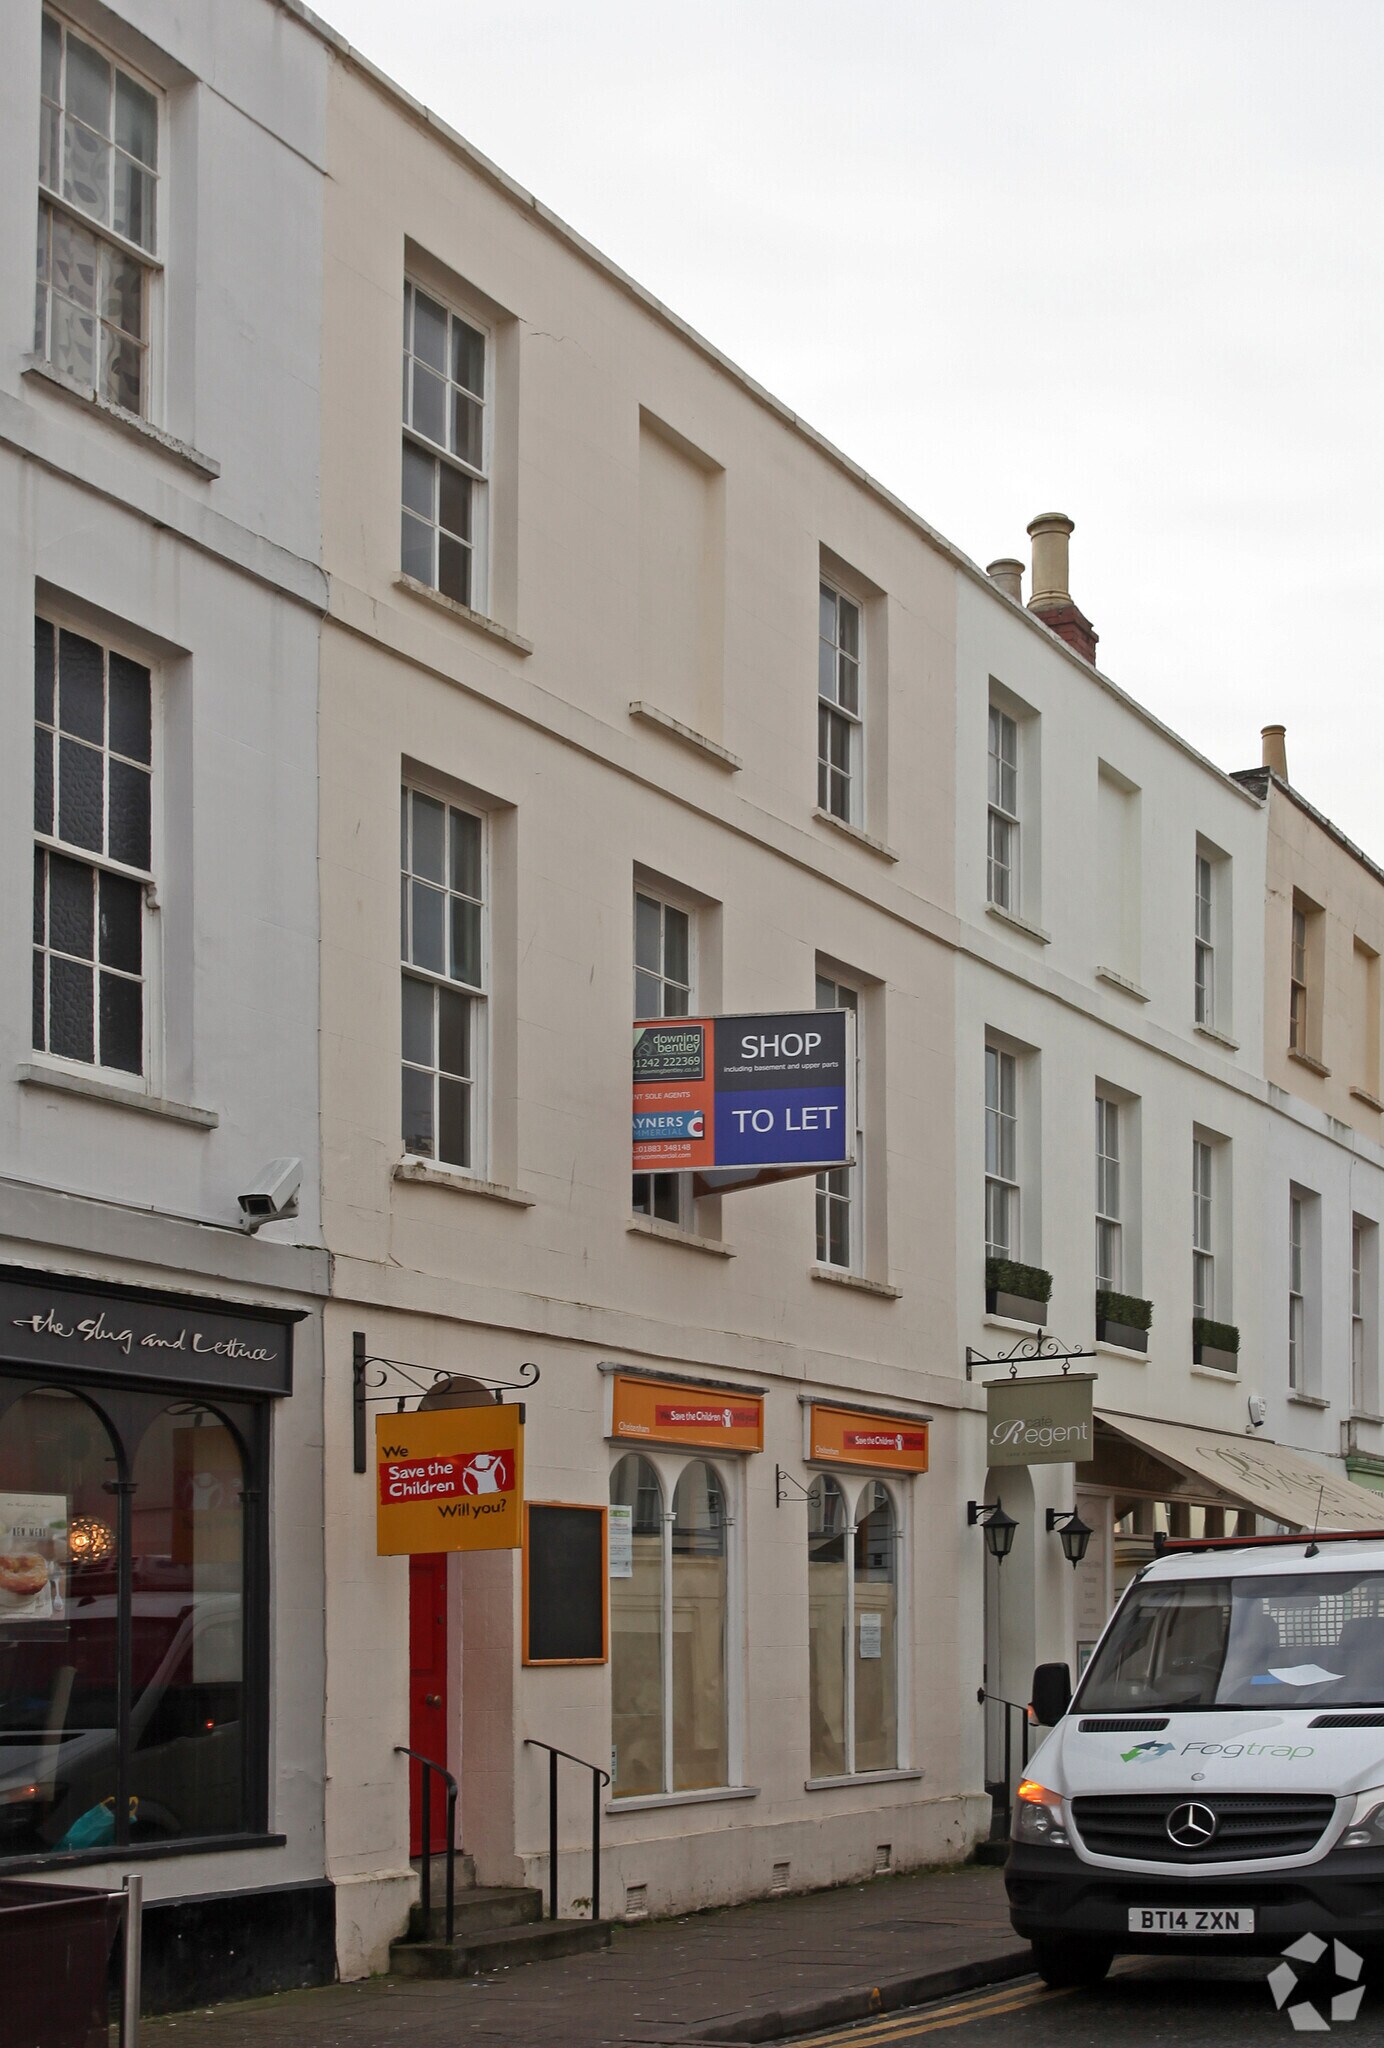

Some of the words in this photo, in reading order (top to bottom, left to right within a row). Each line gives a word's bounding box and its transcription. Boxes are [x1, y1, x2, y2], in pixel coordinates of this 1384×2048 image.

[653, 1033, 700, 1044] downing
[741, 1032, 822, 1059] SHOP
[657, 1042, 700, 1053] bentley
[663, 1056, 701, 1067] 222369
[723, 1064, 753, 1073] including
[754, 1063, 786, 1072] basement
[787, 1062, 800, 1070] and
[801, 1062, 820, 1070] upper
[822, 1061, 839, 1069] parts
[645, 1092, 663, 1100] SOLE
[664, 1091, 691, 1099] AGENTS
[731, 1108, 775, 1133] TO
[785, 1106, 839, 1131] LET
[13, 1309, 74, 1338] the
[78, 1312, 132, 1354] Slug
[141, 1329, 187, 1351] and
[192, 1333, 278, 1361] Lettuce
[670, 1410, 686, 1421] Save
[686, 1411, 697, 1422] the
[696, 1410, 721, 1422] Children
[618, 1421, 650, 1433] Cheltenham
[989, 1419, 1088, 1447] Regent
[382, 1445, 409, 1458] We
[388, 1465, 426, 1480] Save
[428, 1462, 454, 1476] the
[389, 1480, 455, 1497] Children
[437, 1503, 470, 1518] Will
[472, 1498, 507, 1519] you?
[1180, 1742, 1315, 1761] Fogtrap
[1141, 1911, 1188, 1929] BT14
[1195, 1911, 1239, 1930] ZXN
